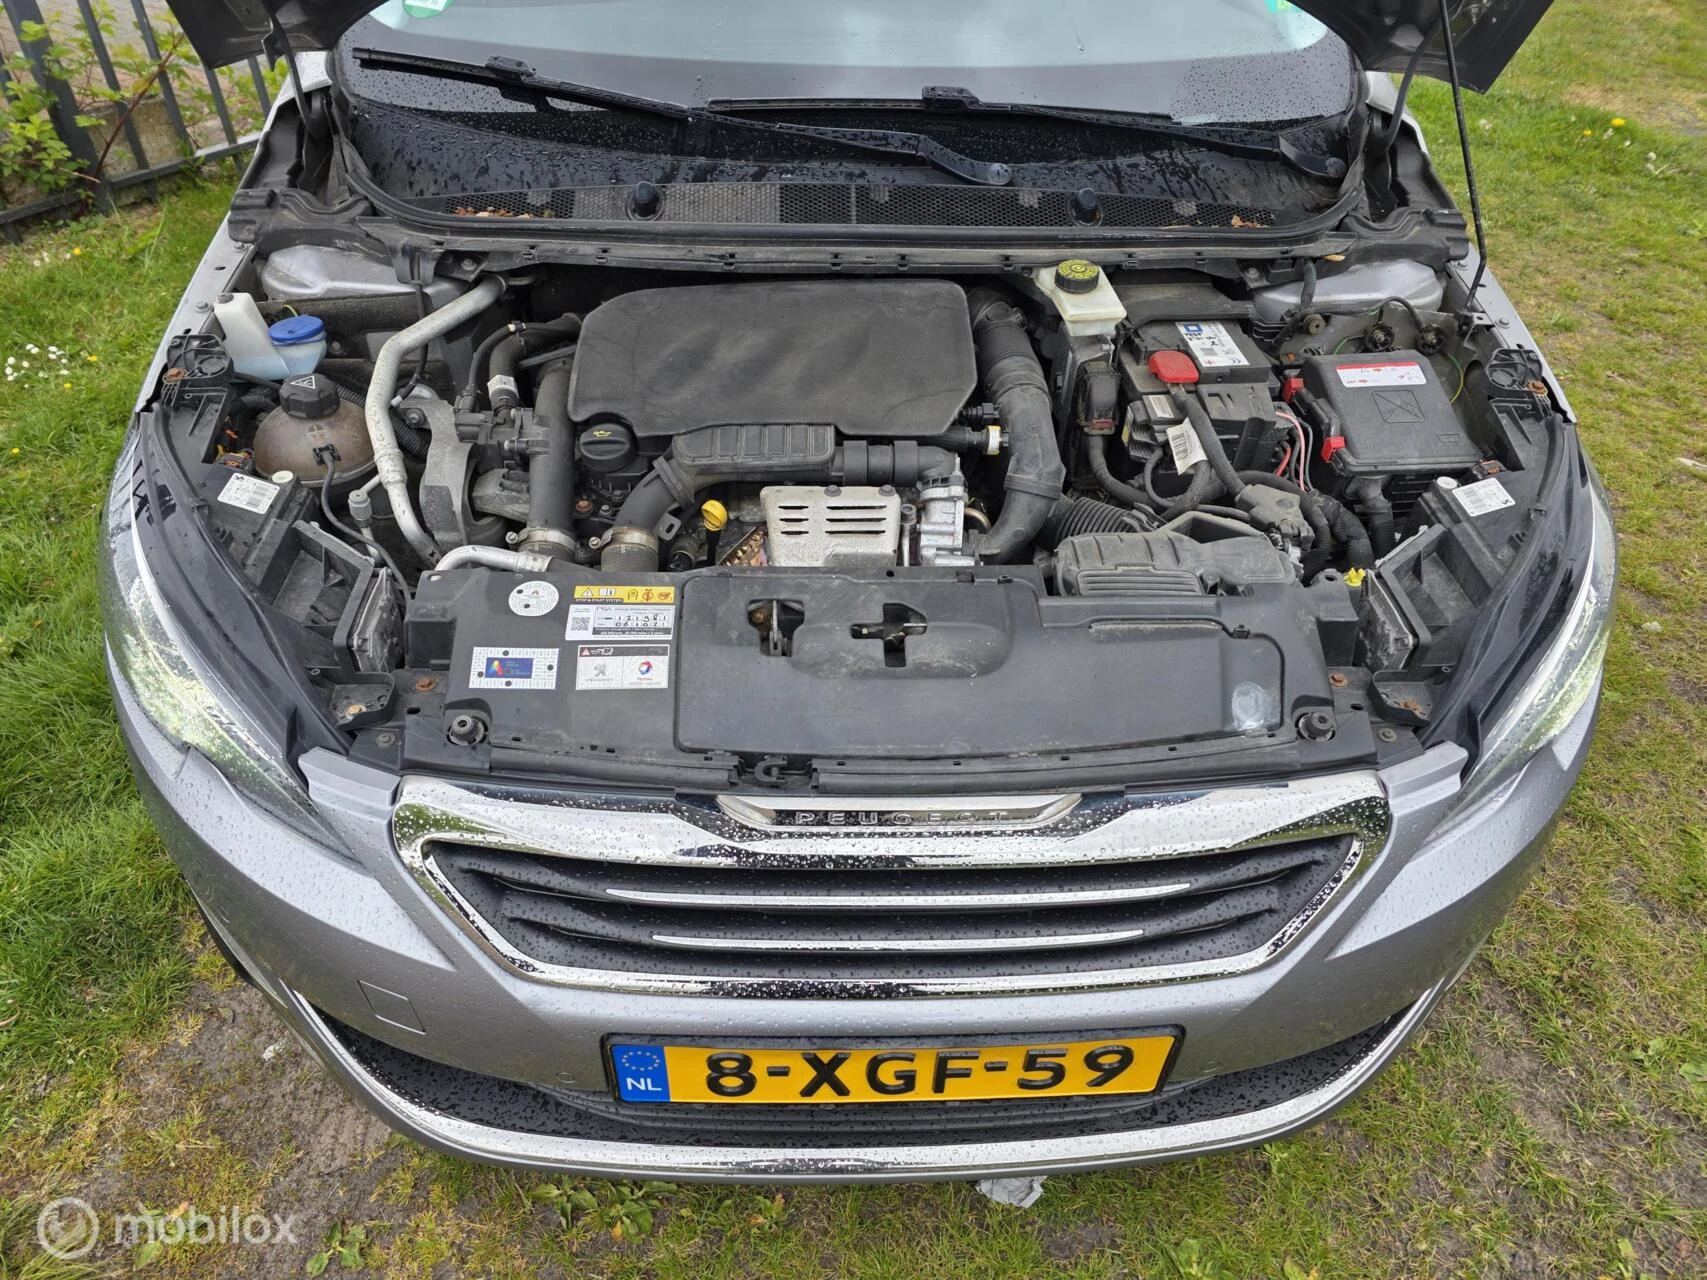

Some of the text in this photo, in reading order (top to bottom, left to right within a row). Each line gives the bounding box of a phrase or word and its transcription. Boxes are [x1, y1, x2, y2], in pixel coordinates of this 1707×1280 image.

[796, 810, 1009, 825] PEUGEOT
[705, 1045, 1135, 1098] 8-XGF-59
[626, 1076, 662, 1092] NL
